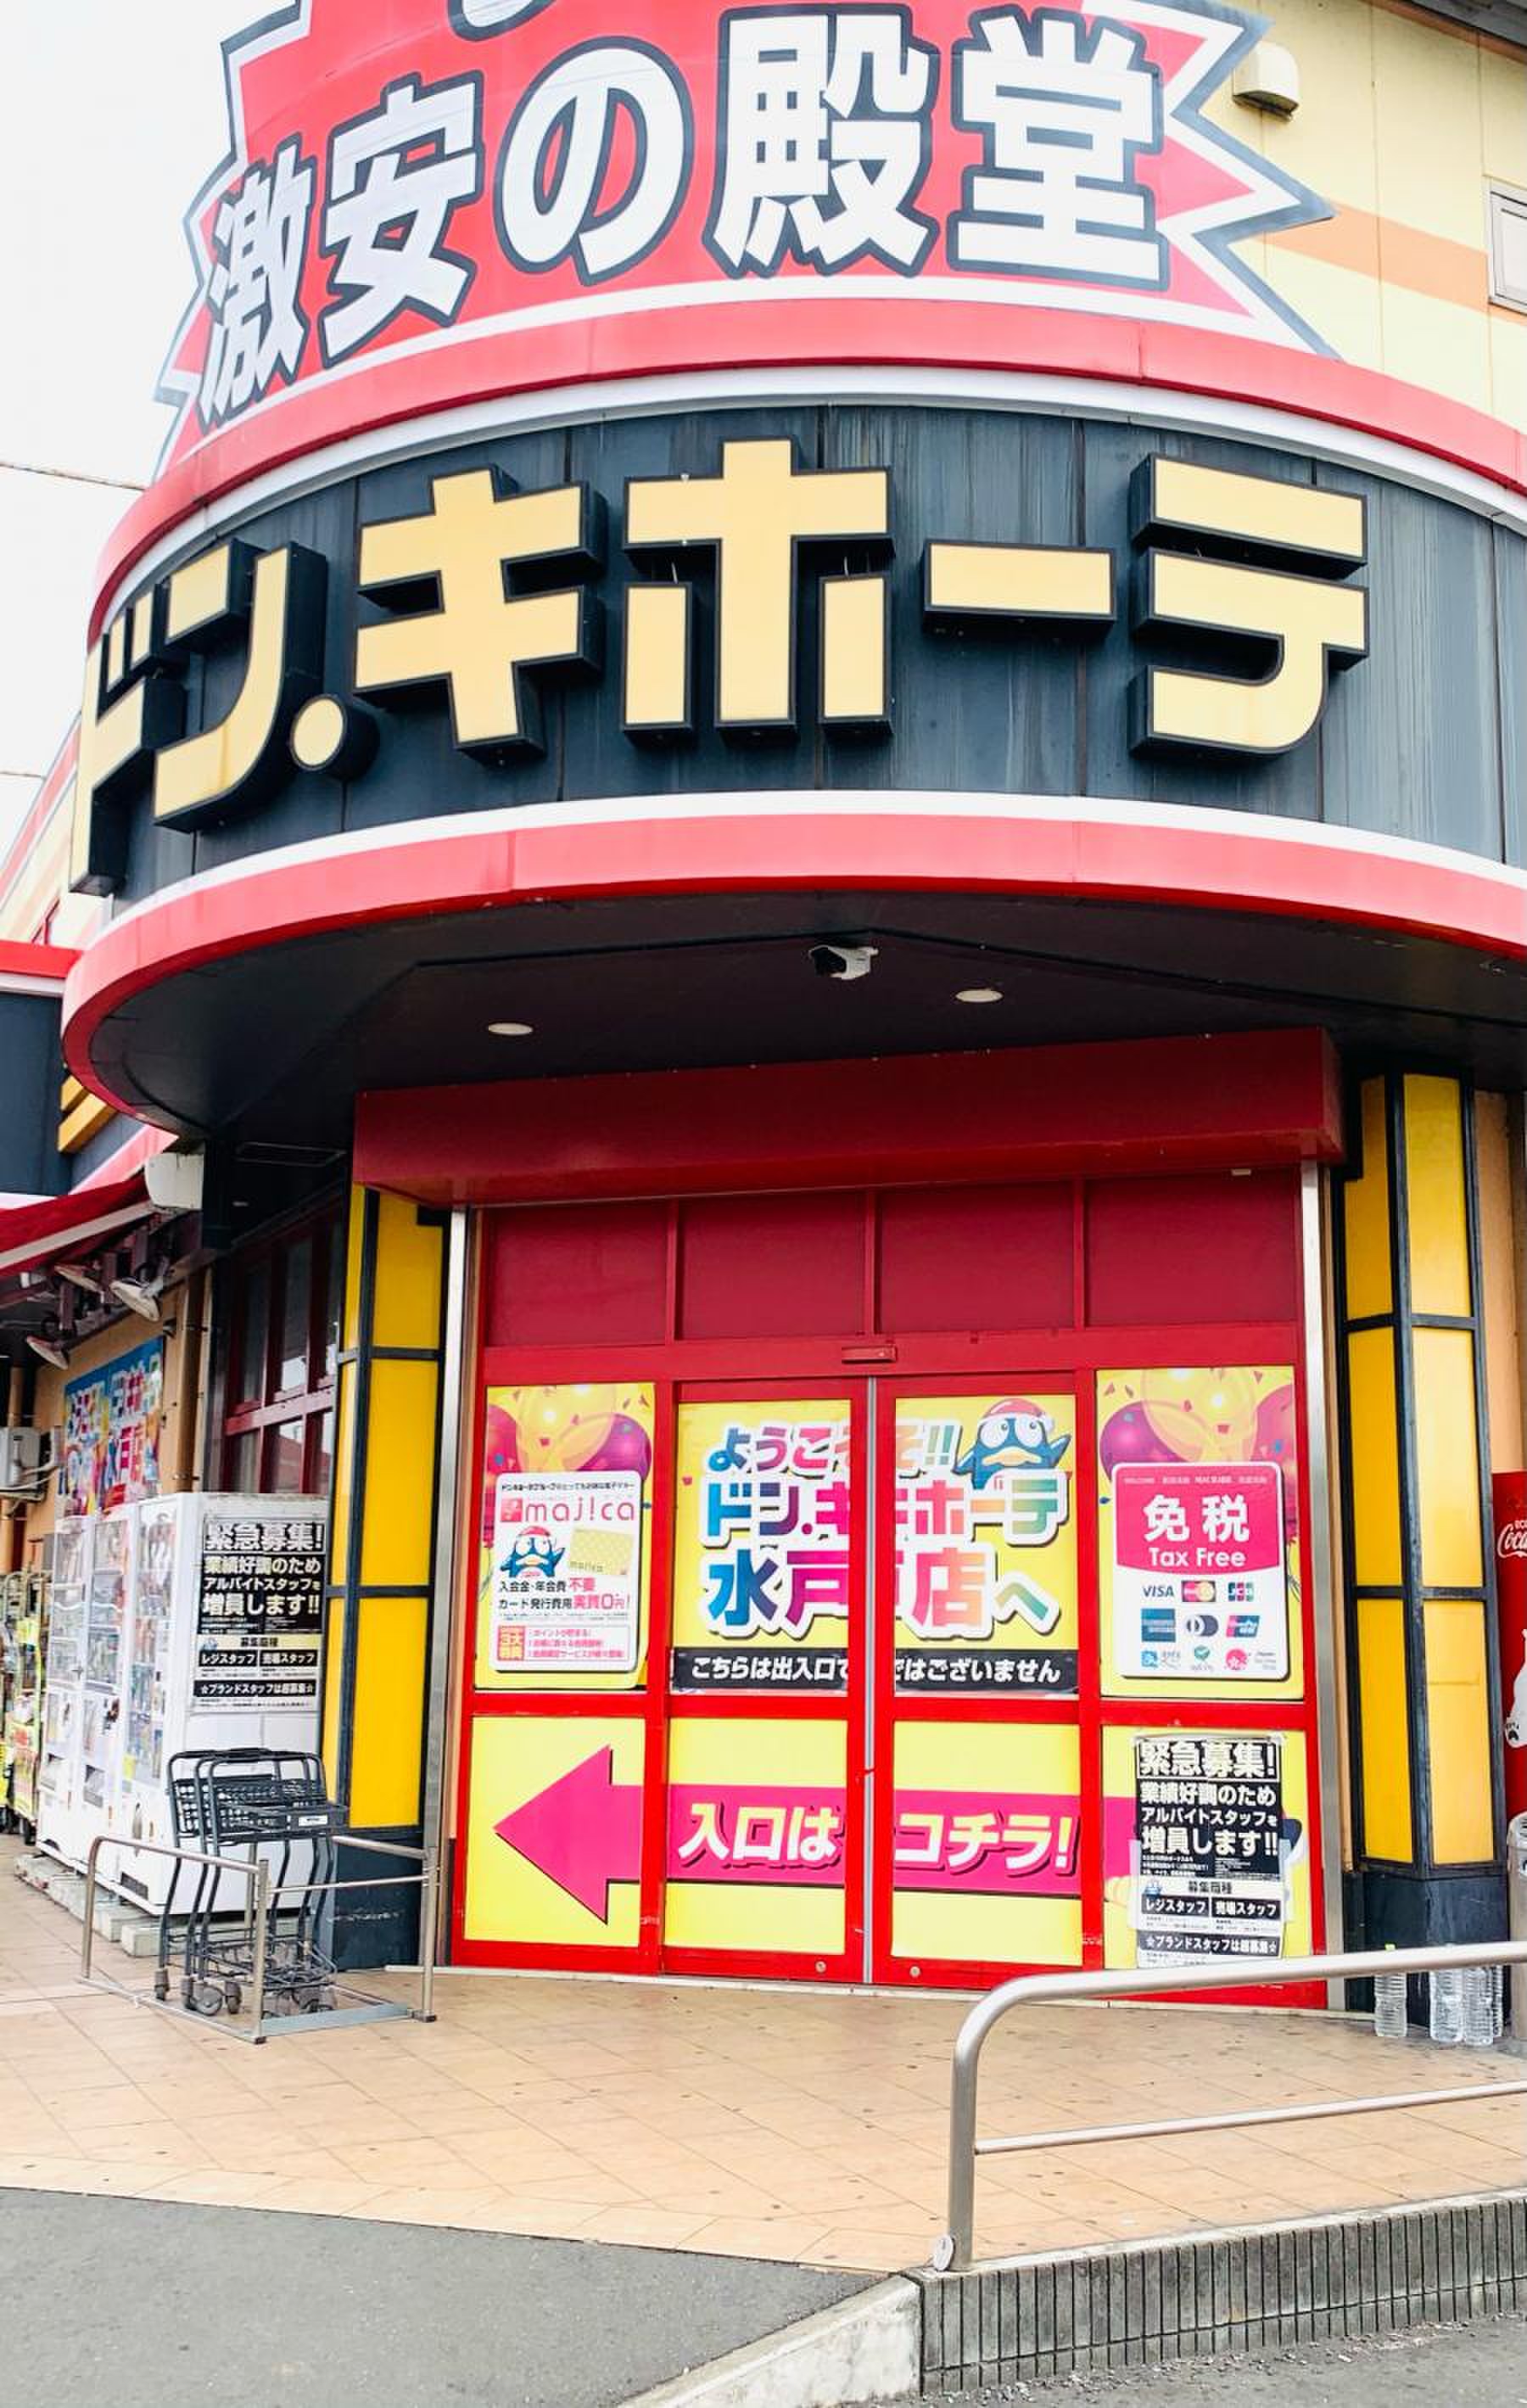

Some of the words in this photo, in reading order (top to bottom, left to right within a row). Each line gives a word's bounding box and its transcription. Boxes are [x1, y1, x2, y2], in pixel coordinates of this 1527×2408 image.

[197, 12, 1168, 422] 激安の殿堂
[1144, 1494, 1250, 1542] 免税
[205, 1522, 322, 1552] 緊急募集!
[1149, 1548, 1189, 1567] Tax
[1196, 1548, 1246, 1567] Free
[1143, 1584, 1175, 1598] VISA
[1139, 1740, 1276, 1778] 緊急募集!
[1141, 1806, 1277, 1827] アルバイトスタッフを
[1142, 1827, 1278, 1856] 増員します!!
